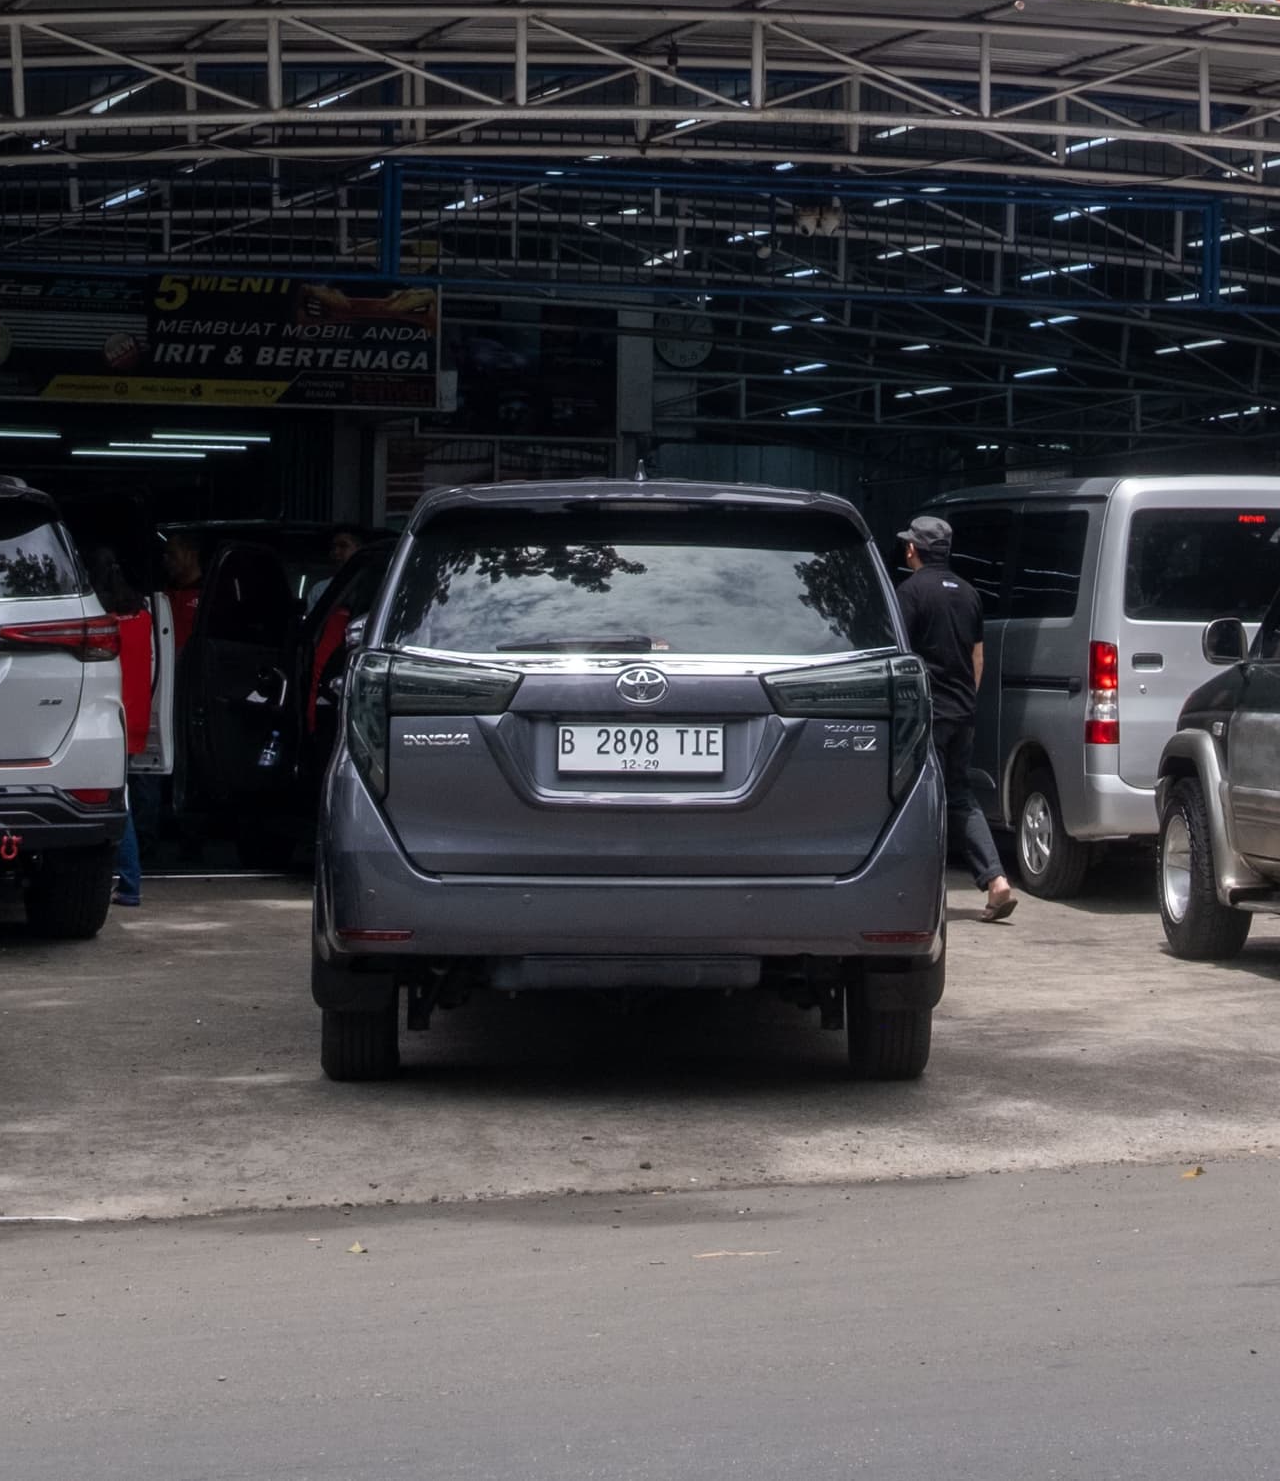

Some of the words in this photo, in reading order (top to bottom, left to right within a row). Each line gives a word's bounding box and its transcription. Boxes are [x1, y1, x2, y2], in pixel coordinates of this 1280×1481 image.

[152, 273, 192, 312] 5
[156, 319, 277, 337] MEMBUAT
[281, 322, 354, 341] MOBIL
[362, 326, 430, 342] ANDA
[153, 342, 216, 364] IRIT
[223, 344, 243, 365] &
[255, 347, 430, 370] BERTENAGA
[561, 728, 575, 754] B
[597, 728, 660, 755] 2898
[675, 728, 720, 757] TIE
[620, 758, 660, 771] 12-29
